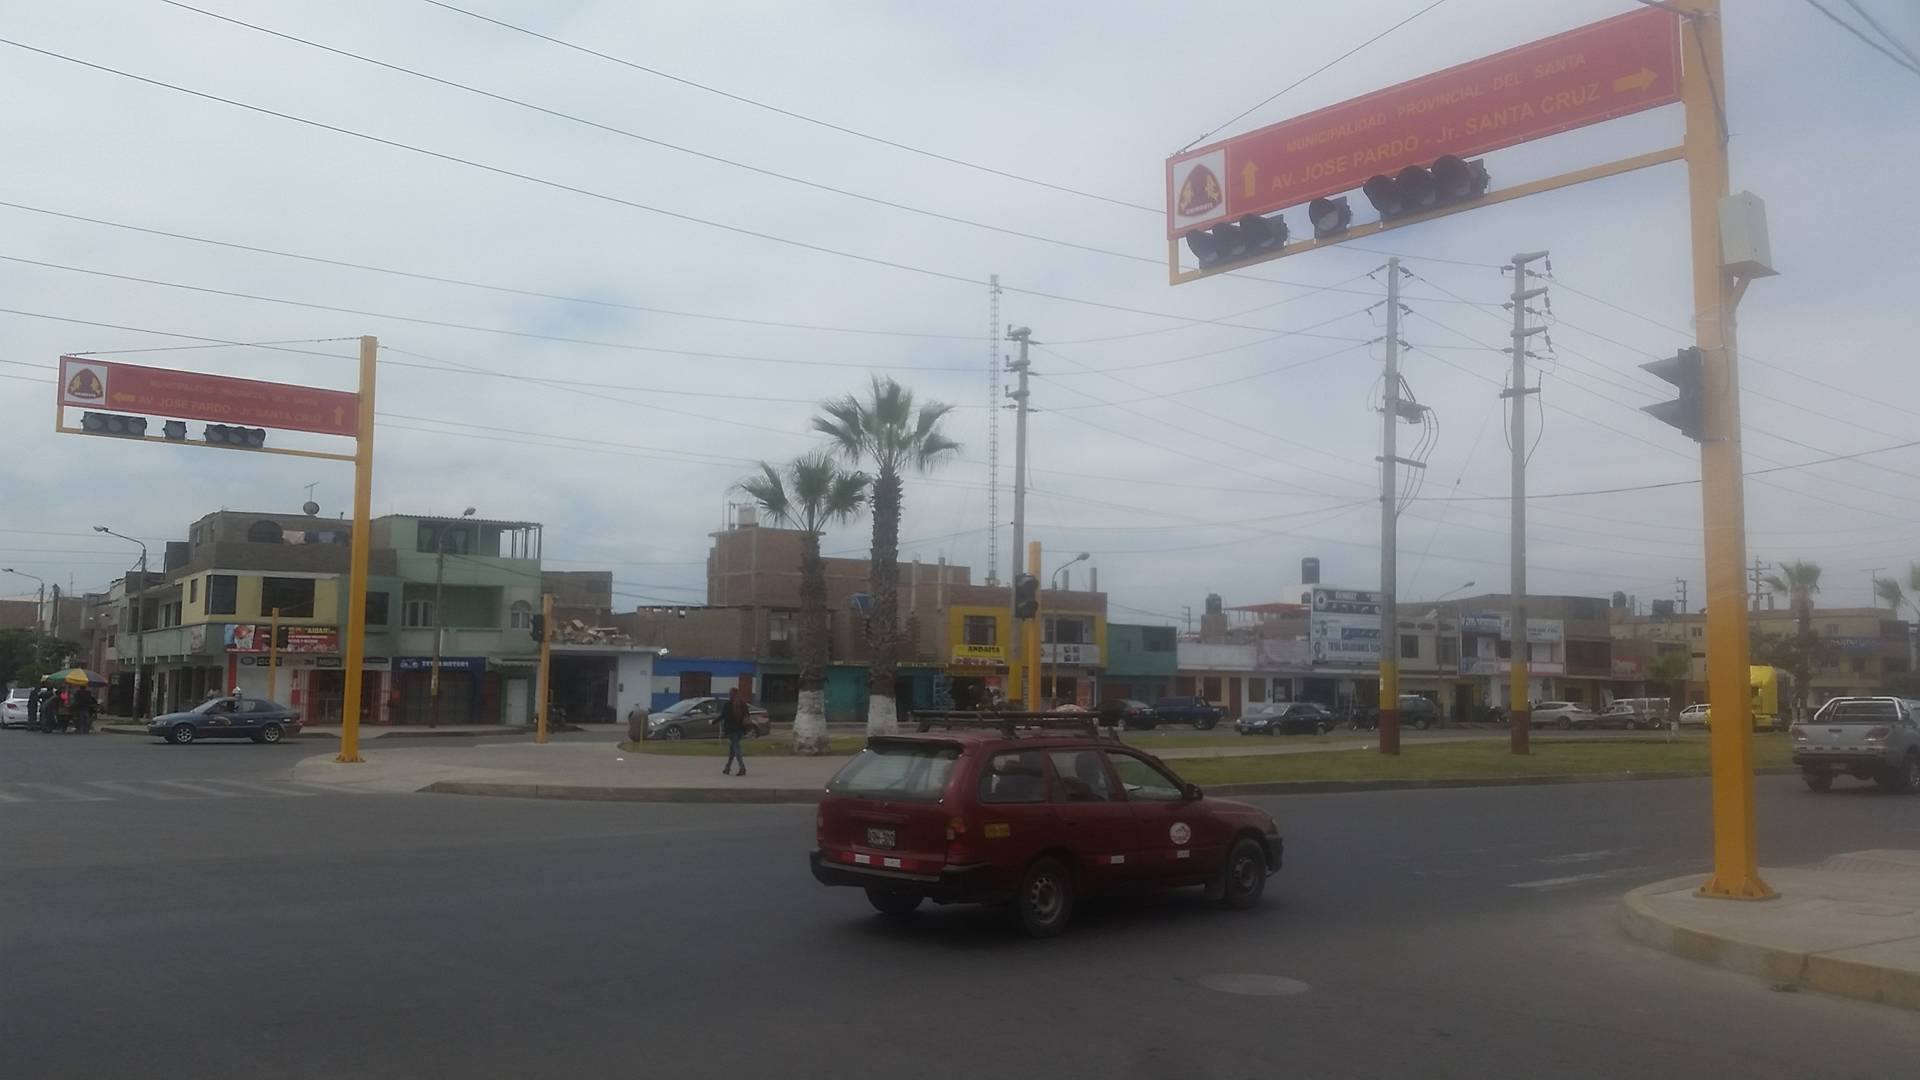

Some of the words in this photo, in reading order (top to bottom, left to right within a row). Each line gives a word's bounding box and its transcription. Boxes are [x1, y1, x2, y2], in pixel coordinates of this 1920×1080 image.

[1271, 172, 1296, 192] AV.
[1301, 155, 1348, 183] JOSE
[1352, 135, 1418, 168] PARDO
[1465, 102, 1535, 135] SANTA
[1540, 81, 1600, 113] CRUZ
[1286, 112, 1387, 153] MUNICIPALIDAD
[1397, 84, 1484, 118] PROVINCIAL
[1493, 71, 1523, 91] DEL
[1535, 53, 1586, 79] SANTA
